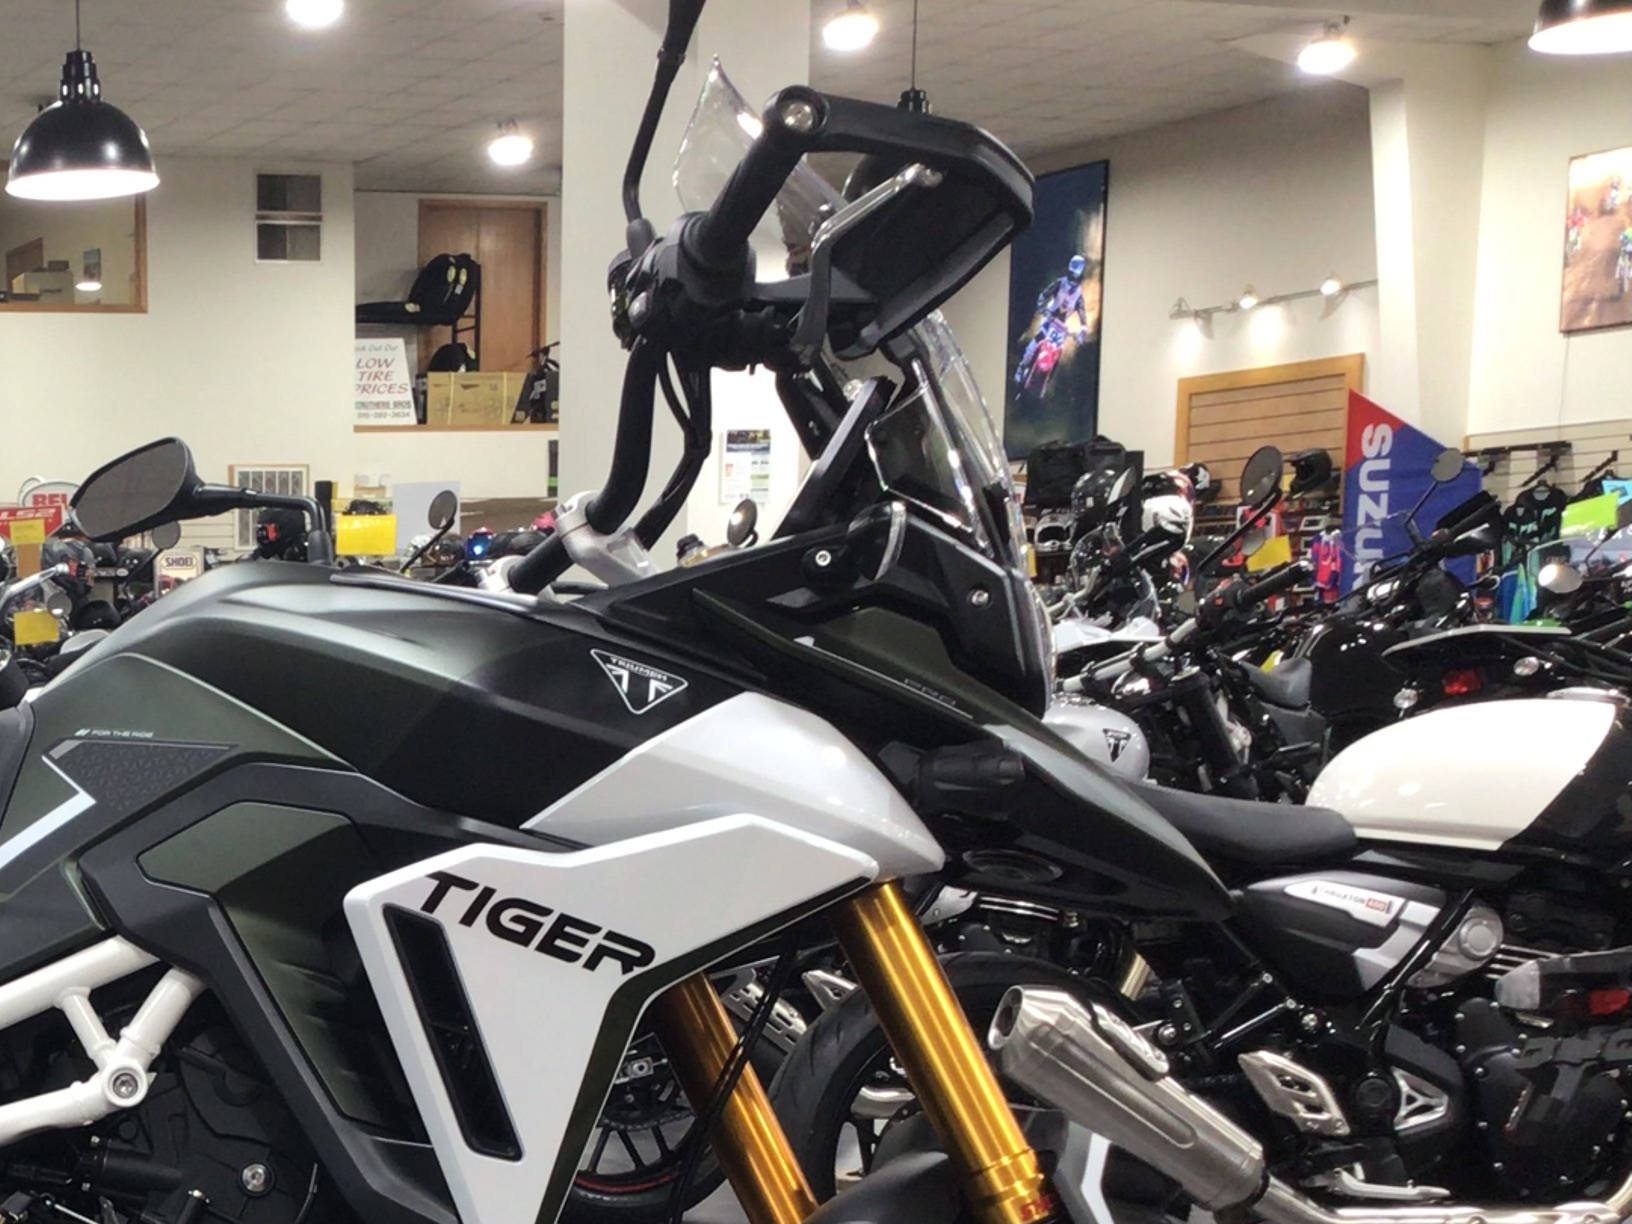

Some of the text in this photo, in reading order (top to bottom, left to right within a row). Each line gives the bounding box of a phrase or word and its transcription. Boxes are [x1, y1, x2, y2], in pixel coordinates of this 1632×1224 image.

[356, 357, 395, 369] LOW
[358, 370, 394, 382] TIRE
[165, 557, 193, 567] SHOEI
[419, 870, 657, 976] TIGER
